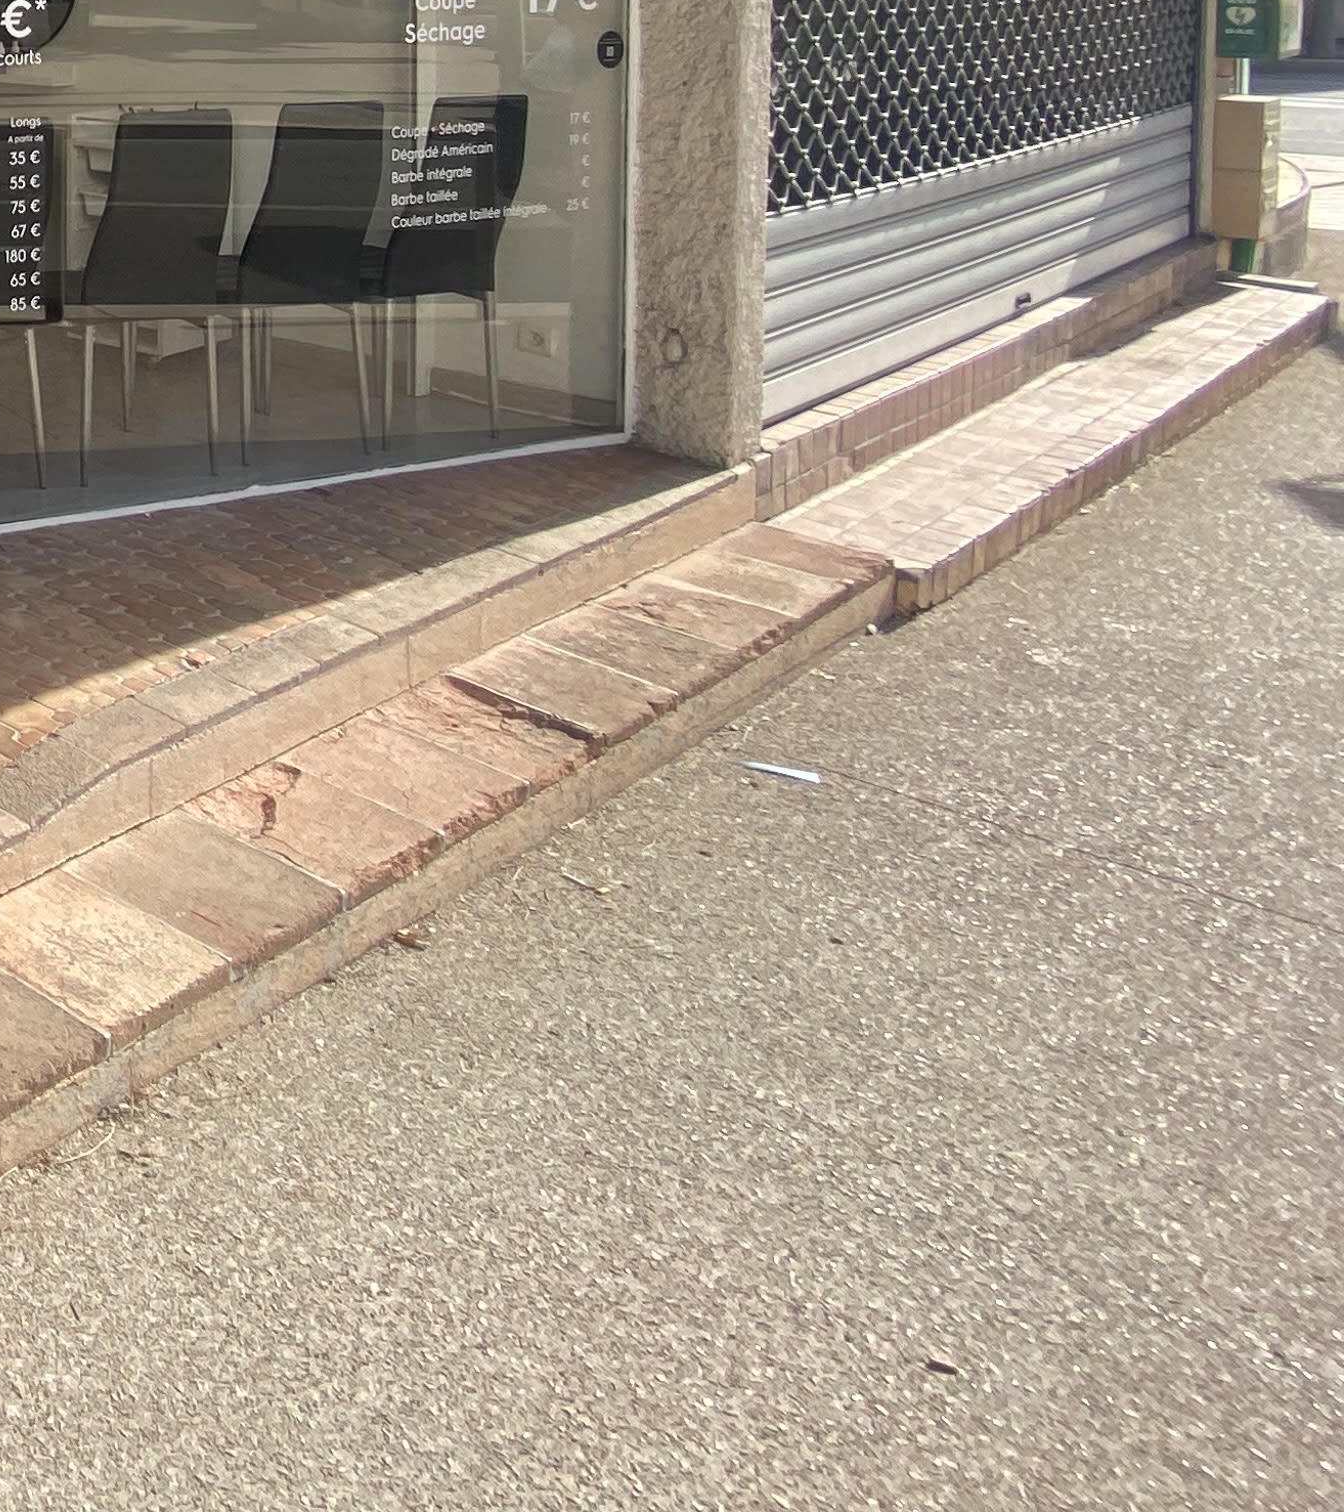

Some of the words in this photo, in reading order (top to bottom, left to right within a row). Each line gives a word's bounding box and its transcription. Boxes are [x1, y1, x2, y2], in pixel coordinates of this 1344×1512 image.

[405, 23, 485, 45] Séchage
[11, 117, 41, 129] Longs
[583, 112, 591, 123] €
[391, 126, 428, 140] Coupe
[439, 121, 485, 136] Séchage
[9, 151, 26, 165] 35
[30, 150, 40, 164] €
[392, 144, 438, 163] Dégradé
[441, 142, 493, 157] Américain
[9, 176, 26, 190] 55
[30, 175, 40, 189] €
[392, 171, 423, 183] Barbe
[427, 166, 472, 182] intégrale
[391, 193, 423, 206] Barbe
[426, 190, 458, 203] taillée
[11, 201, 26, 214] 75
[30, 199, 41, 213] €
[392, 215, 432, 228] Couleur
[435, 211, 466, 224] barbe
[470, 207, 499, 219] taillée
[11, 224, 26, 238] 67
[31, 223, 41, 237] €
[5, 249, 26, 263] 180
[31, 248, 41, 261] €
[10, 272, 26, 287] 65
[31, 271, 41, 285] €
[10, 297, 26, 312] 85
[31, 296, 41, 310] €
